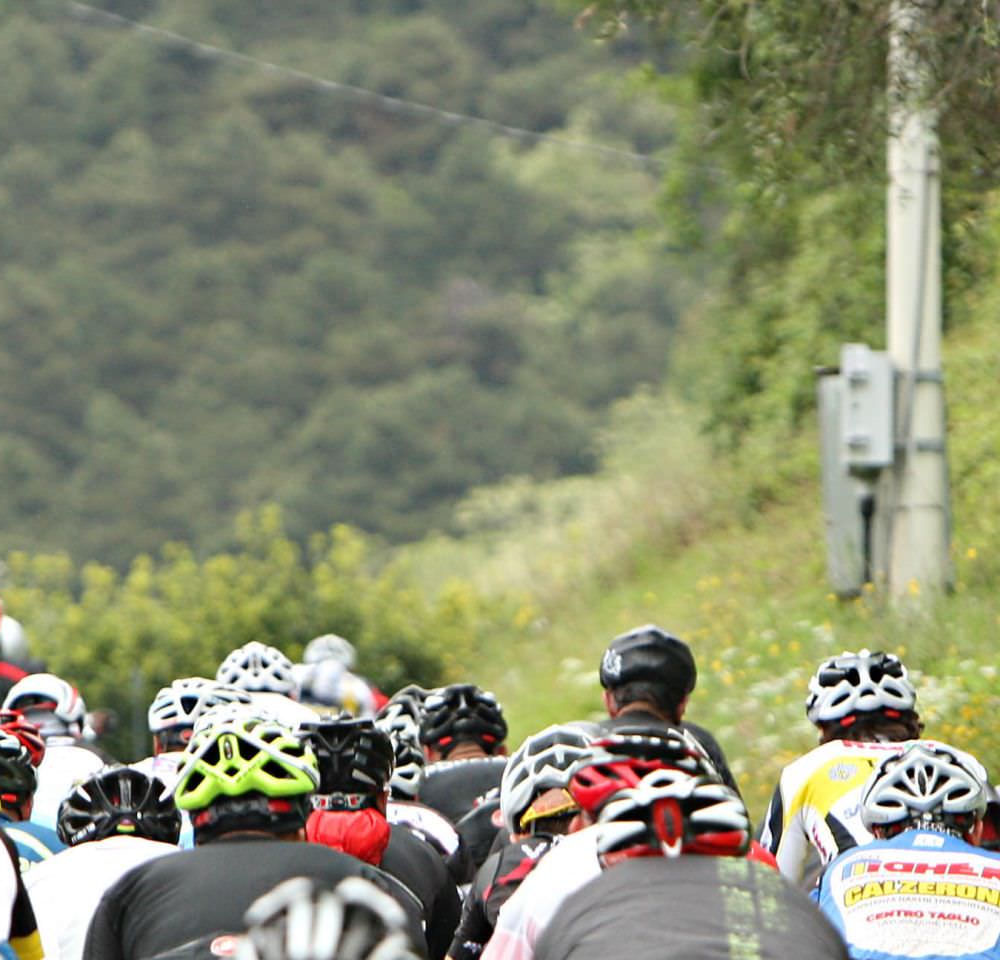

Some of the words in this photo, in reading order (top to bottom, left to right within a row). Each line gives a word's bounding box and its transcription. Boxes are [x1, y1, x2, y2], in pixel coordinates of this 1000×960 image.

[844, 880, 1000, 907] CALZERON
[866, 909, 924, 922] CENTRO
[928, 911, 980, 926] TAGLIO
